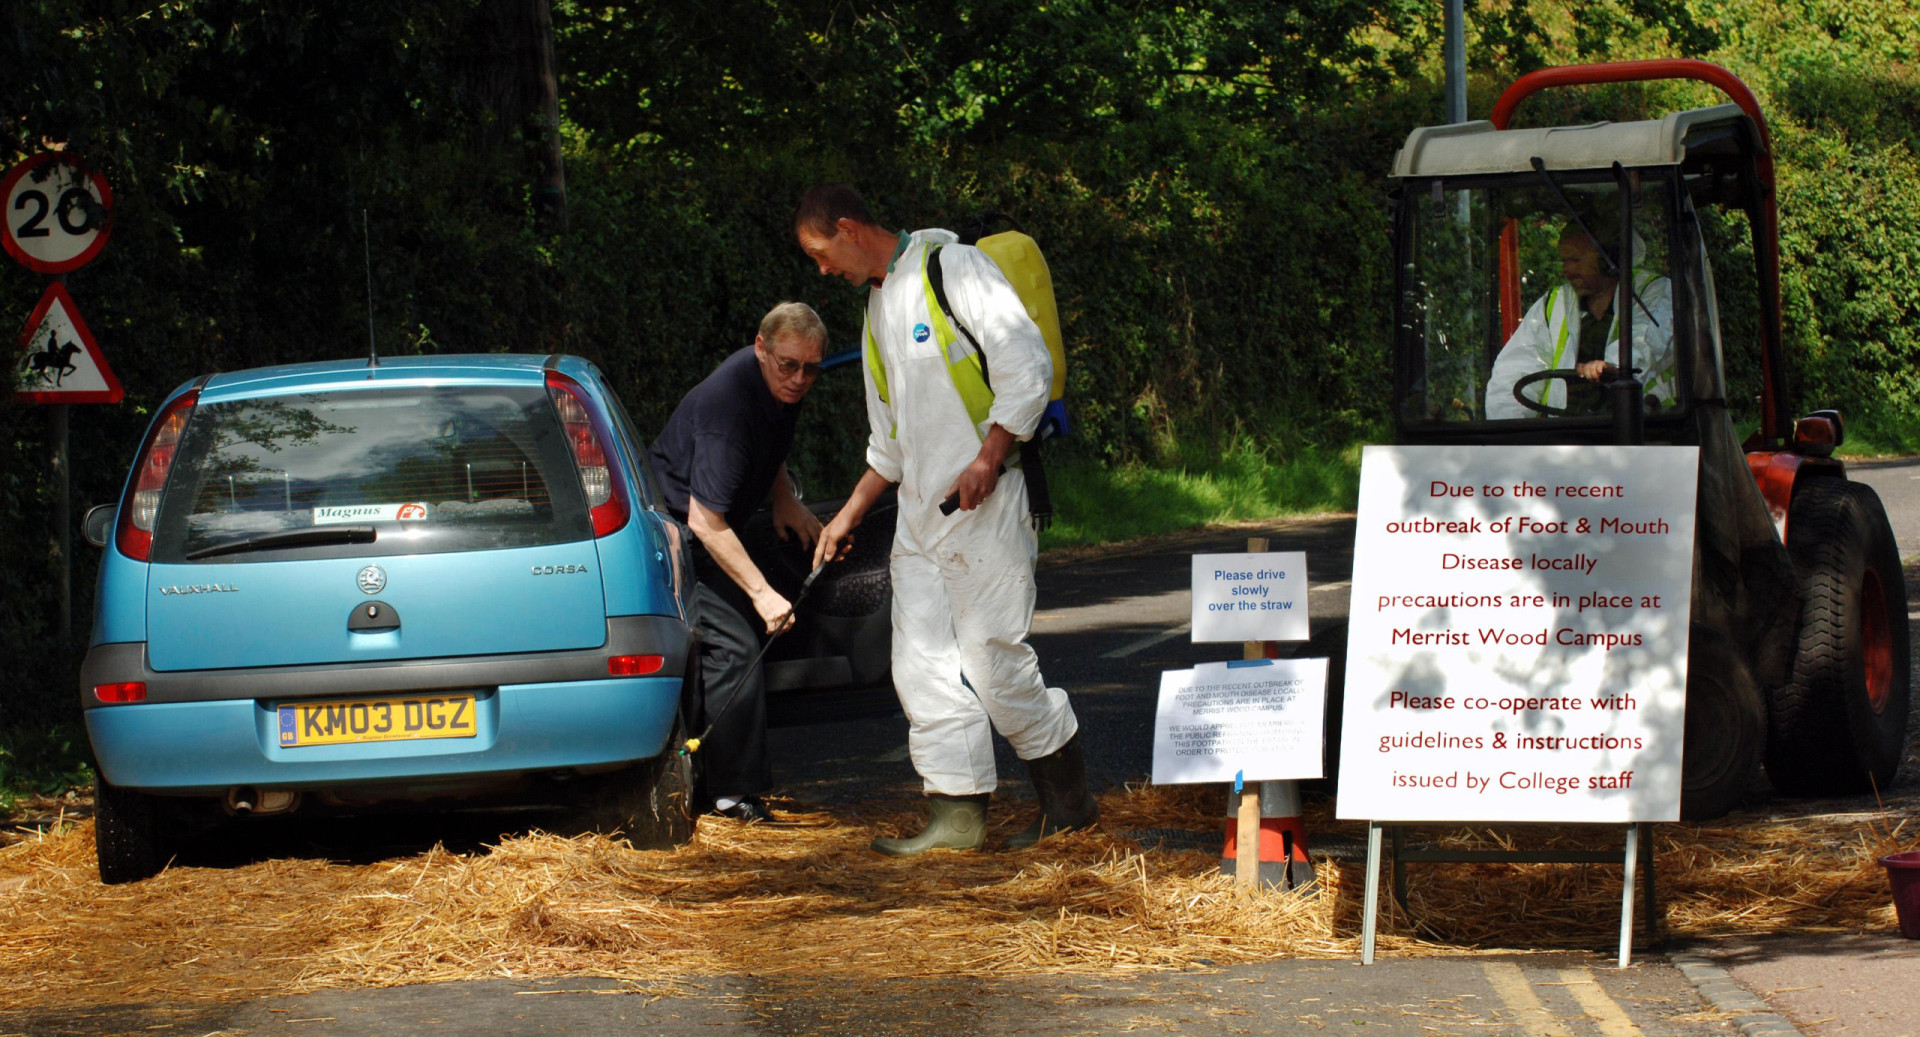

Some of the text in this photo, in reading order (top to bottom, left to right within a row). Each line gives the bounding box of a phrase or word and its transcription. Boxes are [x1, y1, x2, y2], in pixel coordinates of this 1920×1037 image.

[15, 188, 96, 238] 20
[1431, 481, 1623, 498] Due to the recent
[318, 507, 381, 518] Magnus
[1386, 516, 1669, 534] outbreak of Foot & Mouth
[530, 562, 588, 576] CORSA
[1443, 553, 1597, 574] Disease locally
[1214, 569, 1285, 580] Please drive
[158, 583, 239, 597] VAUXHALL
[1232, 585, 1269, 597] slowly
[1209, 601, 1292, 611] over the straw
[1378, 592, 1660, 612] precautions are in place at
[1392, 628, 1642, 651] Merrist Wood Campus
[1254, 680, 1293, 688] OUTBREAK
[1183, 700, 1234, 708] PRECAUTIONS
[1390, 692, 1636, 715] Please co-operate with
[304, 698, 469, 737] KM03 DGZ
[1380, 731, 1642, 753] guidelines & instructions
[1393, 771, 1633, 794] issued by College staff
